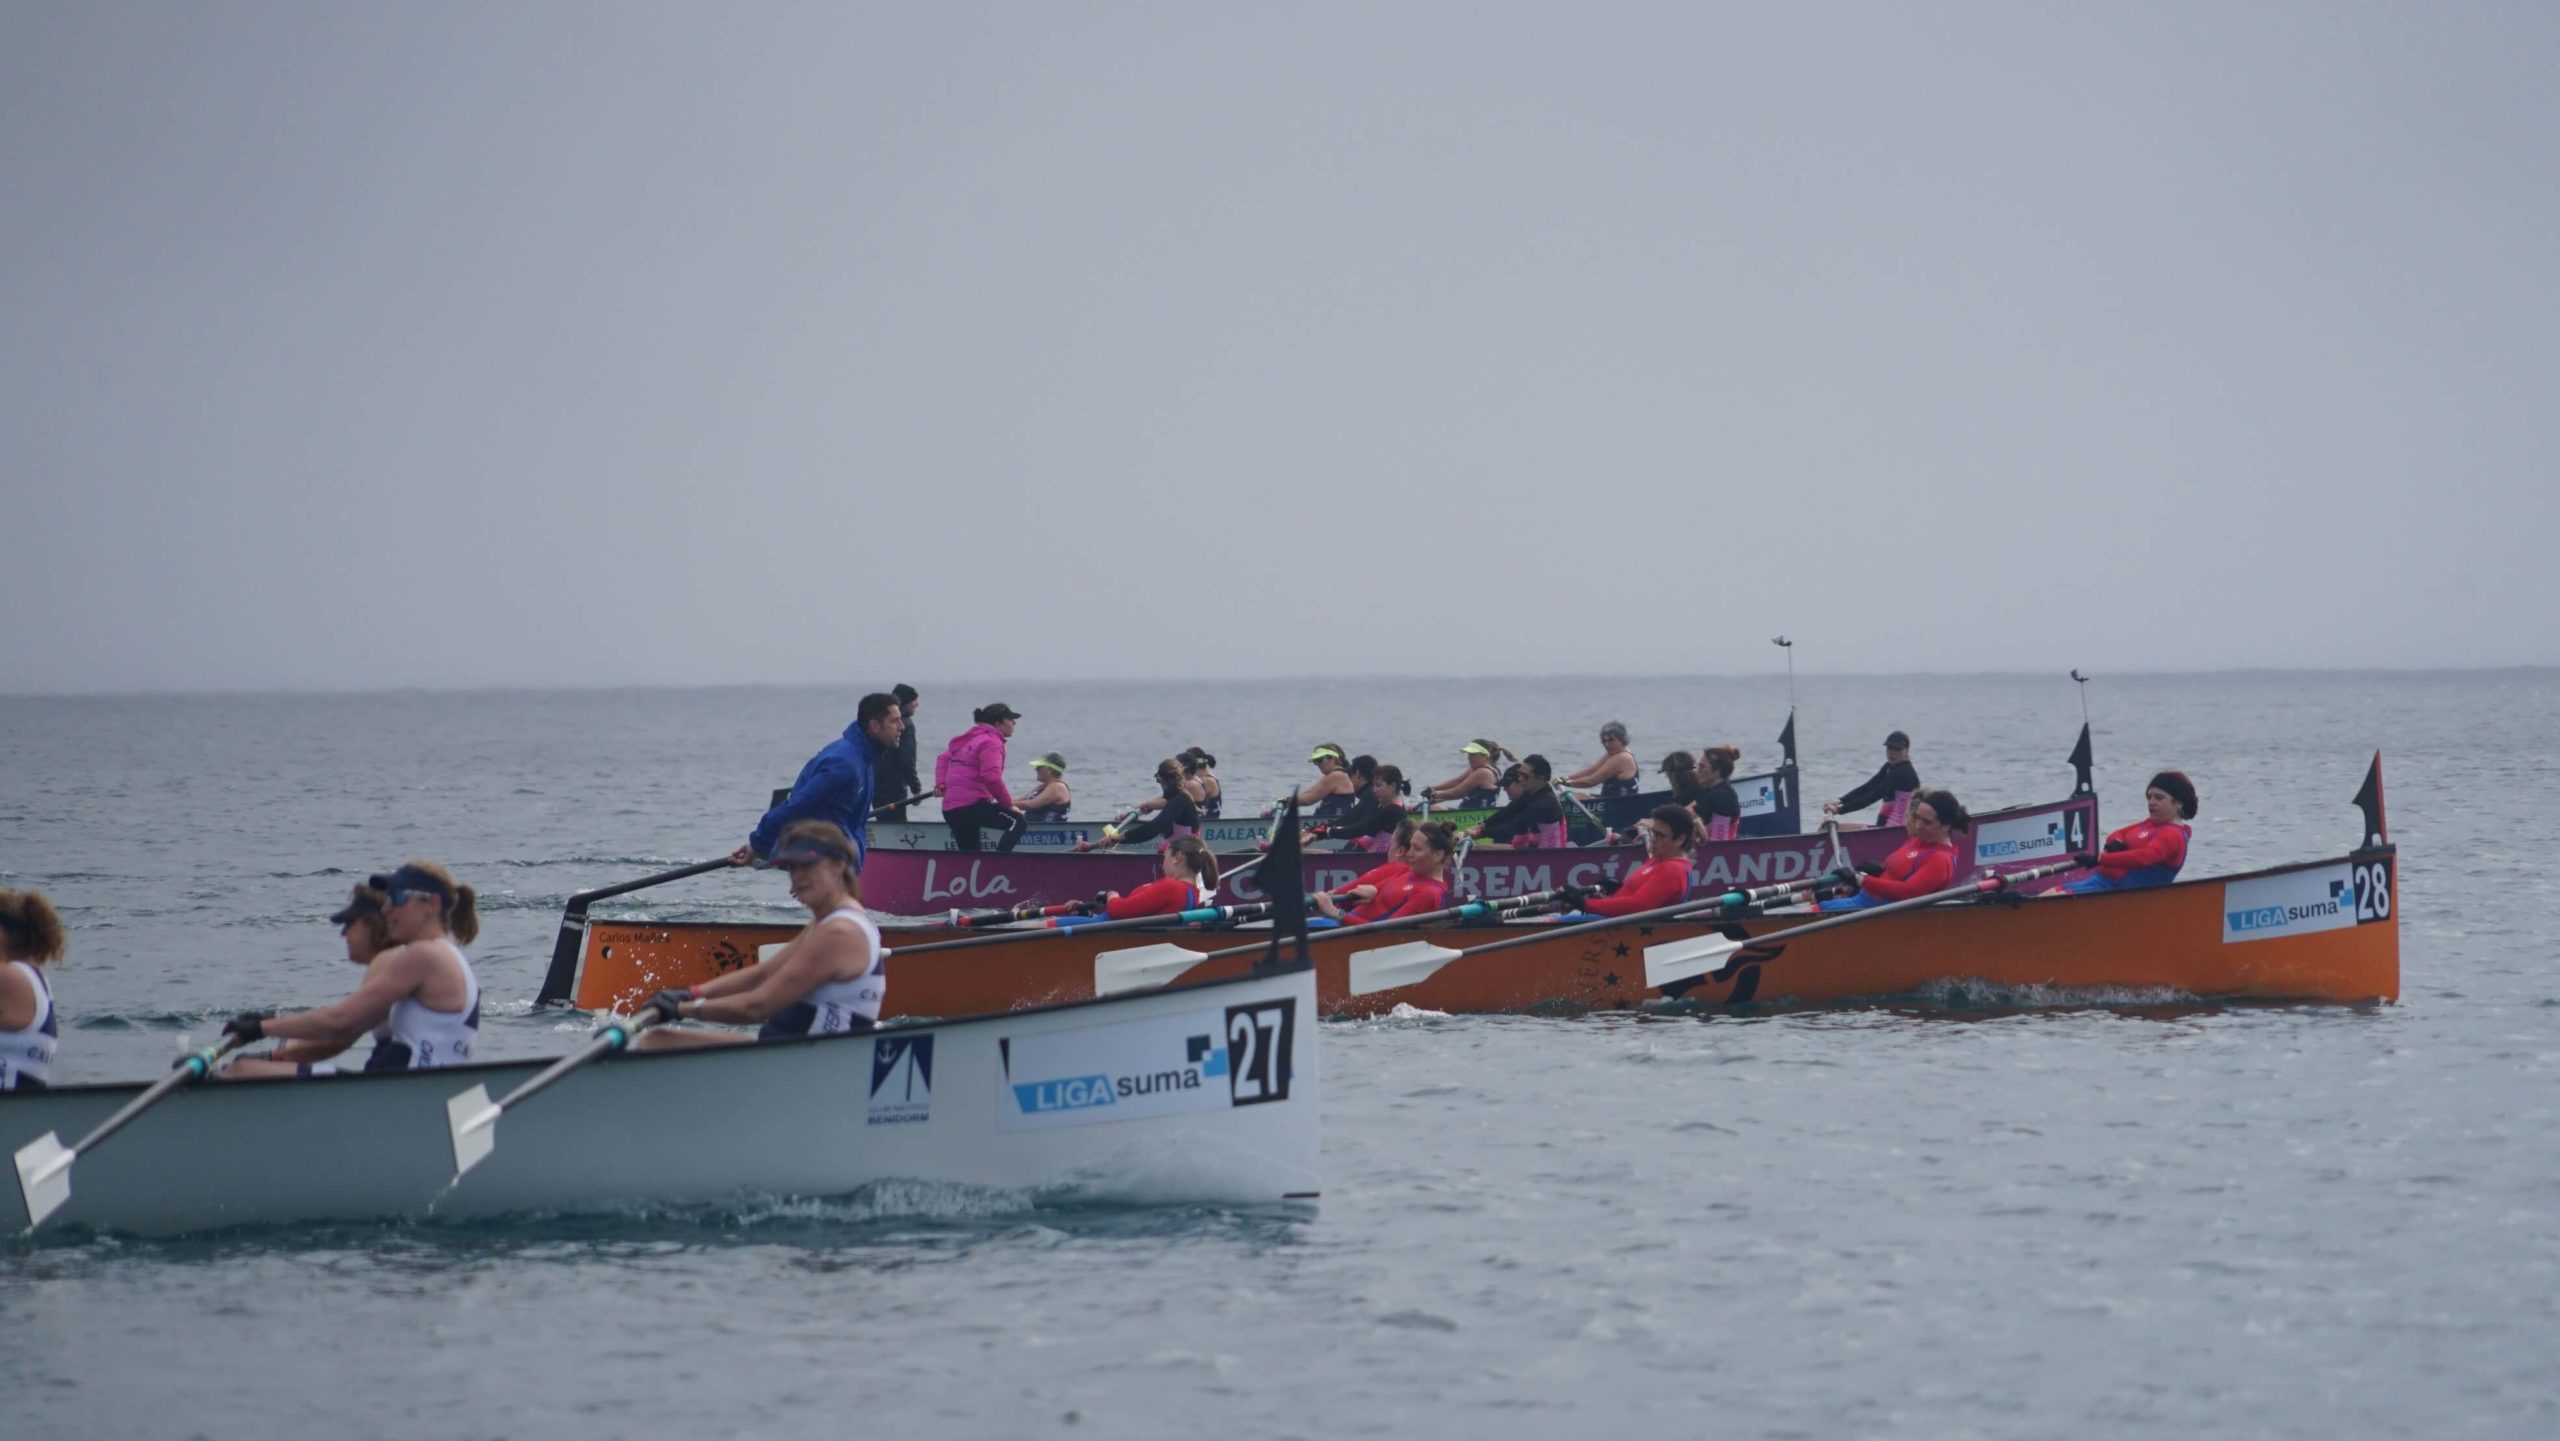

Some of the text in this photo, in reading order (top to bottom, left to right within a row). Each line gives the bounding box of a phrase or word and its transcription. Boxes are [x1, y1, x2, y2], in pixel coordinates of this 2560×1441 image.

[1572, 802, 1606, 813] BUE
[1779, 777, 1788, 808] 1
[1987, 836, 2055, 857] LIGA suma
[2070, 811, 2084, 849] 4
[922, 858, 1018, 902] Lola
[1451, 865, 1552, 898] REM
[1690, 842, 1856, 887] ANDÍA
[2354, 863, 2391, 921] 28
[2241, 900, 2339, 930] LIGA suma
[599, 931, 631, 944] Carlos
[1229, 1008, 1284, 1100] 27
[1036, 1068, 1201, 1111] LIGA suma
[868, 1112, 930, 1125] BENIDORM
